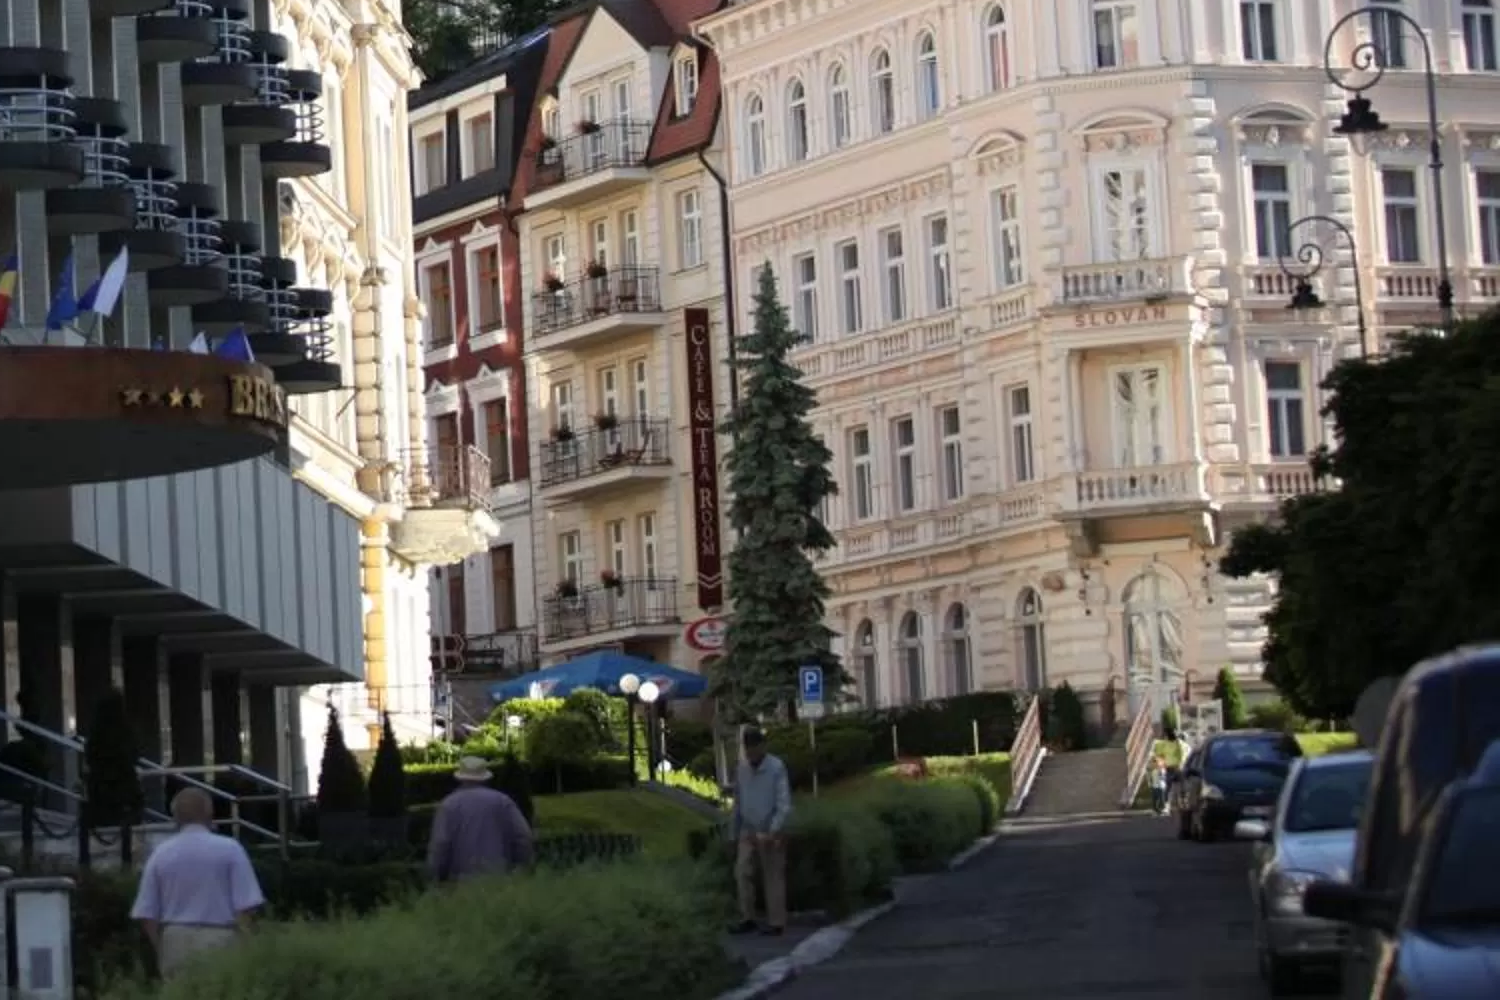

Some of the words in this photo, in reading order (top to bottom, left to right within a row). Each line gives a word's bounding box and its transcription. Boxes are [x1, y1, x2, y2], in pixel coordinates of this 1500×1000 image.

[1075, 306, 1166, 328] SLOVAN
[700, 487, 715, 556] ROOM
[804, 671, 817, 692] P
